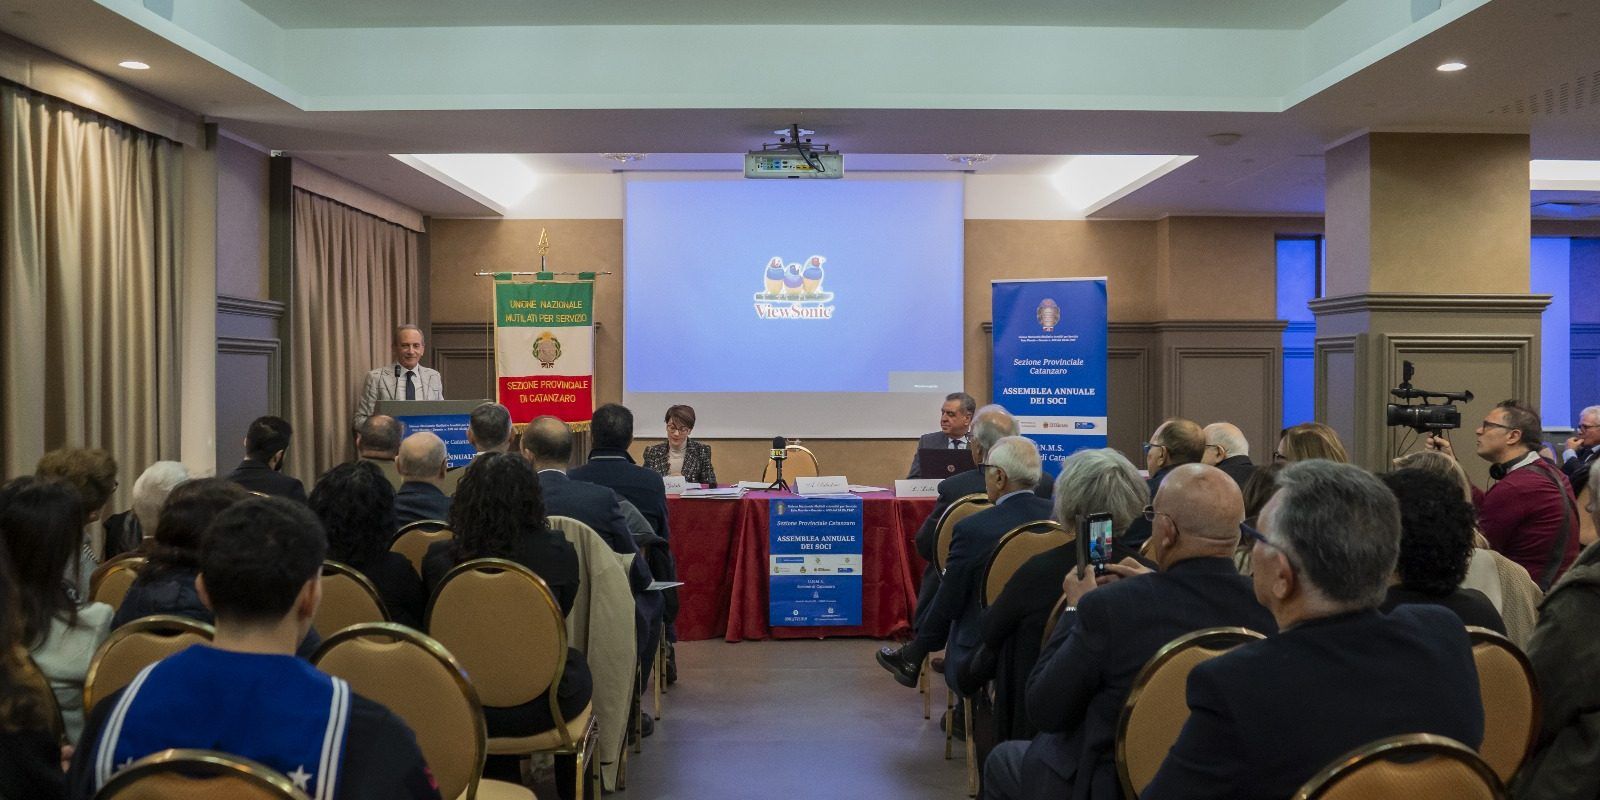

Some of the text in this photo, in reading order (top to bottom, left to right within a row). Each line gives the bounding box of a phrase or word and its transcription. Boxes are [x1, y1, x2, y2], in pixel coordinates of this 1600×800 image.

[510, 300, 582, 309] UNIONE NAZIONALE
[756, 304, 831, 318] ViewSonic
[506, 314, 587, 322] MUTILATI PER SERVIZIO
[1043, 358, 1084, 366] Provinciale
[1030, 367, 1067, 375] Catanzaro
[507, 380, 588, 390] SEZIONE PROVINCIALE
[1003, 387, 1095, 396] ASSEMBLEA ANNUALE
[520, 394, 576, 403] DI CATANZARO
